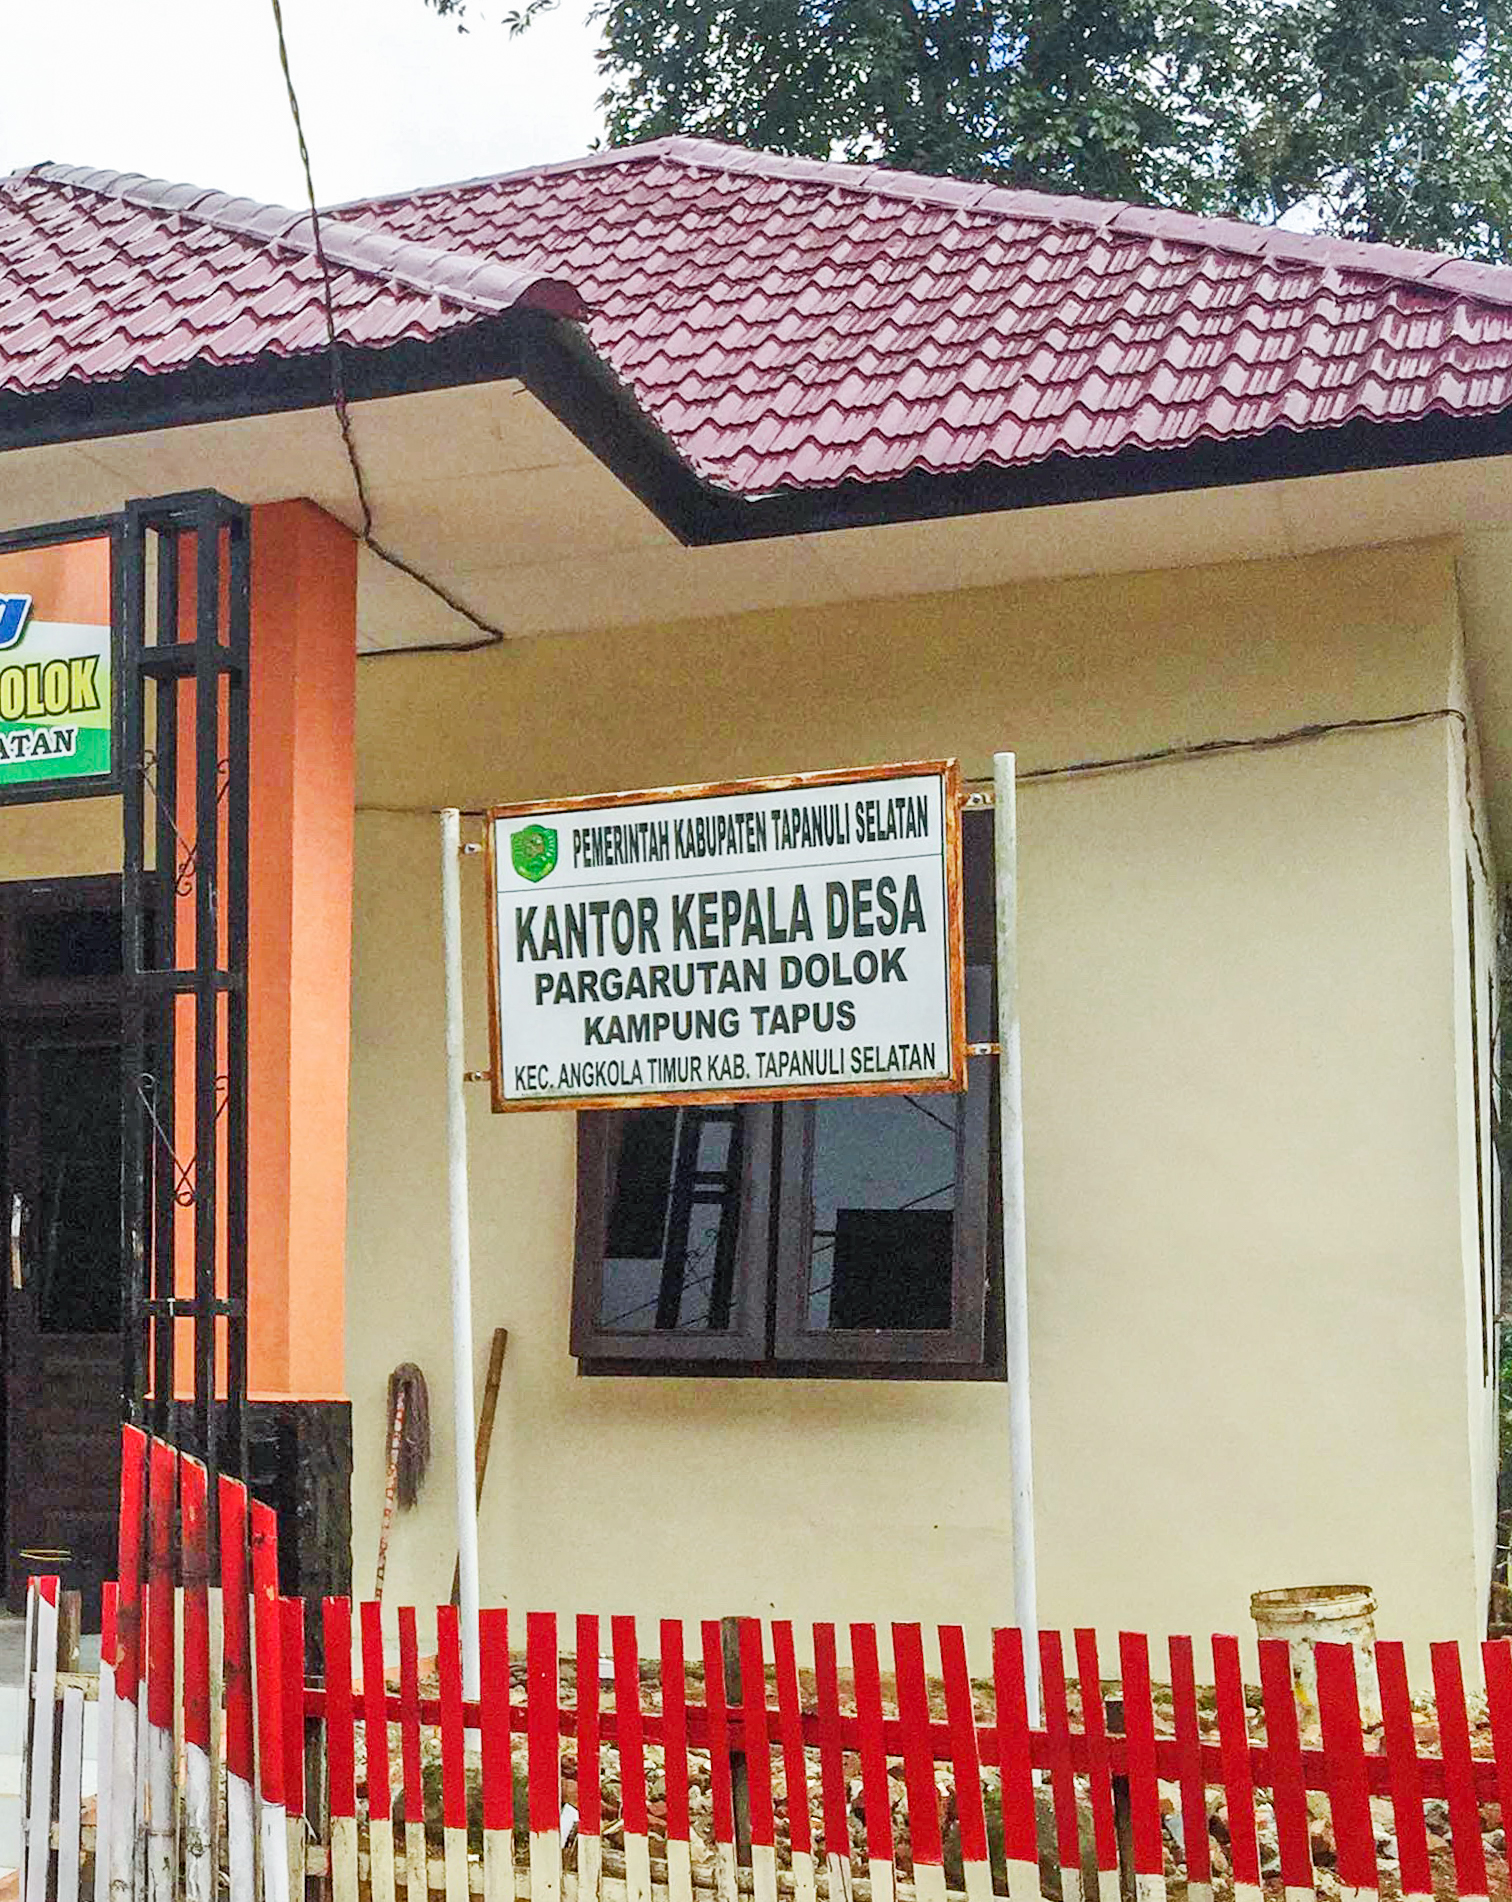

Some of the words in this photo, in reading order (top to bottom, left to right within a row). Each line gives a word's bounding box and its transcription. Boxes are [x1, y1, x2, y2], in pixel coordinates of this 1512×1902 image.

[572, 821, 671, 869] PEMERINTAH
[674, 810, 767, 858] KABUPATEN
[772, 801, 851, 849] TAPANULI
[855, 795, 929, 843] SELATAN
[515, 897, 660, 963] KANTOR
[672, 884, 813, 951] KEPALA
[826, 874, 926, 941] DESA
[535, 958, 766, 1007] PARGARUTAN
[780, 947, 908, 990] DOLOK
[584, 1006, 739, 1046] KAMPUNG
[751, 1000, 856, 1035] TAPUS
[515, 1064, 555, 1092] KEC.
[557, 1058, 643, 1089] ANGKOLA
[648, 1055, 703, 1085] TIMUR
[708, 1052, 751, 1082] KAB.
[756, 1047, 845, 1080] TAPANULI
[850, 1042, 936, 1074] SELATAN
